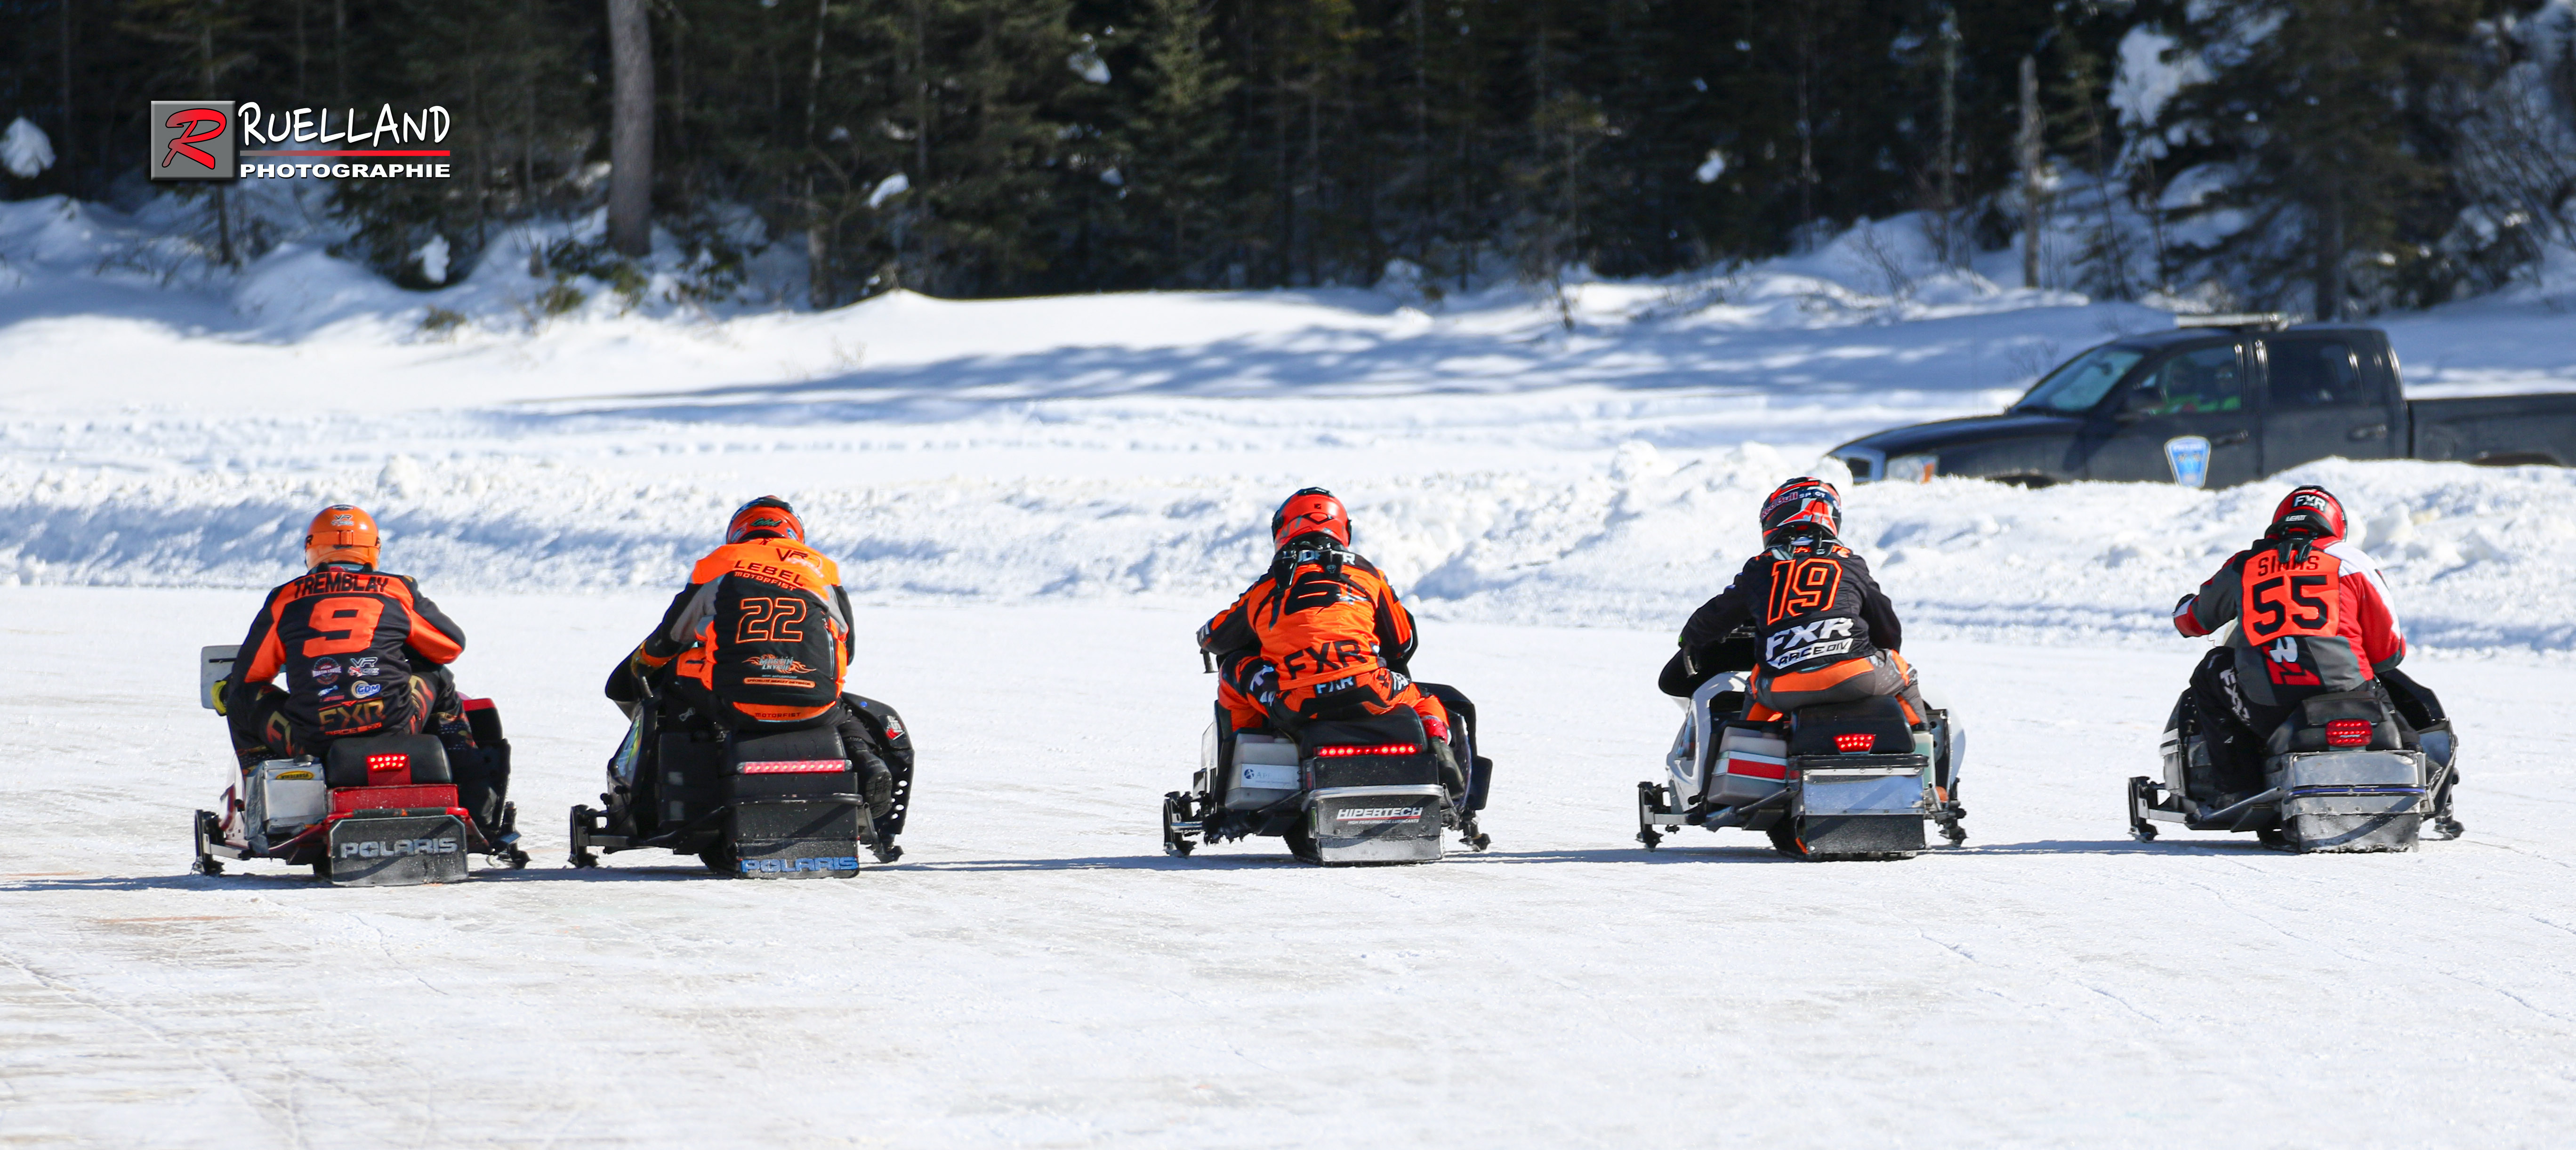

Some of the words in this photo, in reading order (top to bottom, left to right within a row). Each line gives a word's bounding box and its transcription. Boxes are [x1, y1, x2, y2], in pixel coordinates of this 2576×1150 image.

[1776, 492, 1798, 505] Bull
[2294, 495, 2326, 511] FXR
[294, 571, 389, 599] TREMBLAY
[734, 560, 803, 587] LEBEL
[734, 571, 797, 591] MOTORFIST
[1767, 558, 1843, 626] 19
[2252, 575, 2329, 636] 55
[302, 596, 385, 658] 9
[735, 597, 807, 643] 22
[1766, 617, 1854, 660] FXR
[759, 657, 794, 665] MARTIN
[1283, 639, 1367, 680] FXR
[1778, 646, 1825, 666] RACE
[357, 684, 380, 693] GDM
[319, 700, 387, 731] FXR
[1336, 807, 1424, 820] HIPERTECH
[340, 837, 458, 859] POLARIS
[741, 856, 858, 873] POLARIS
